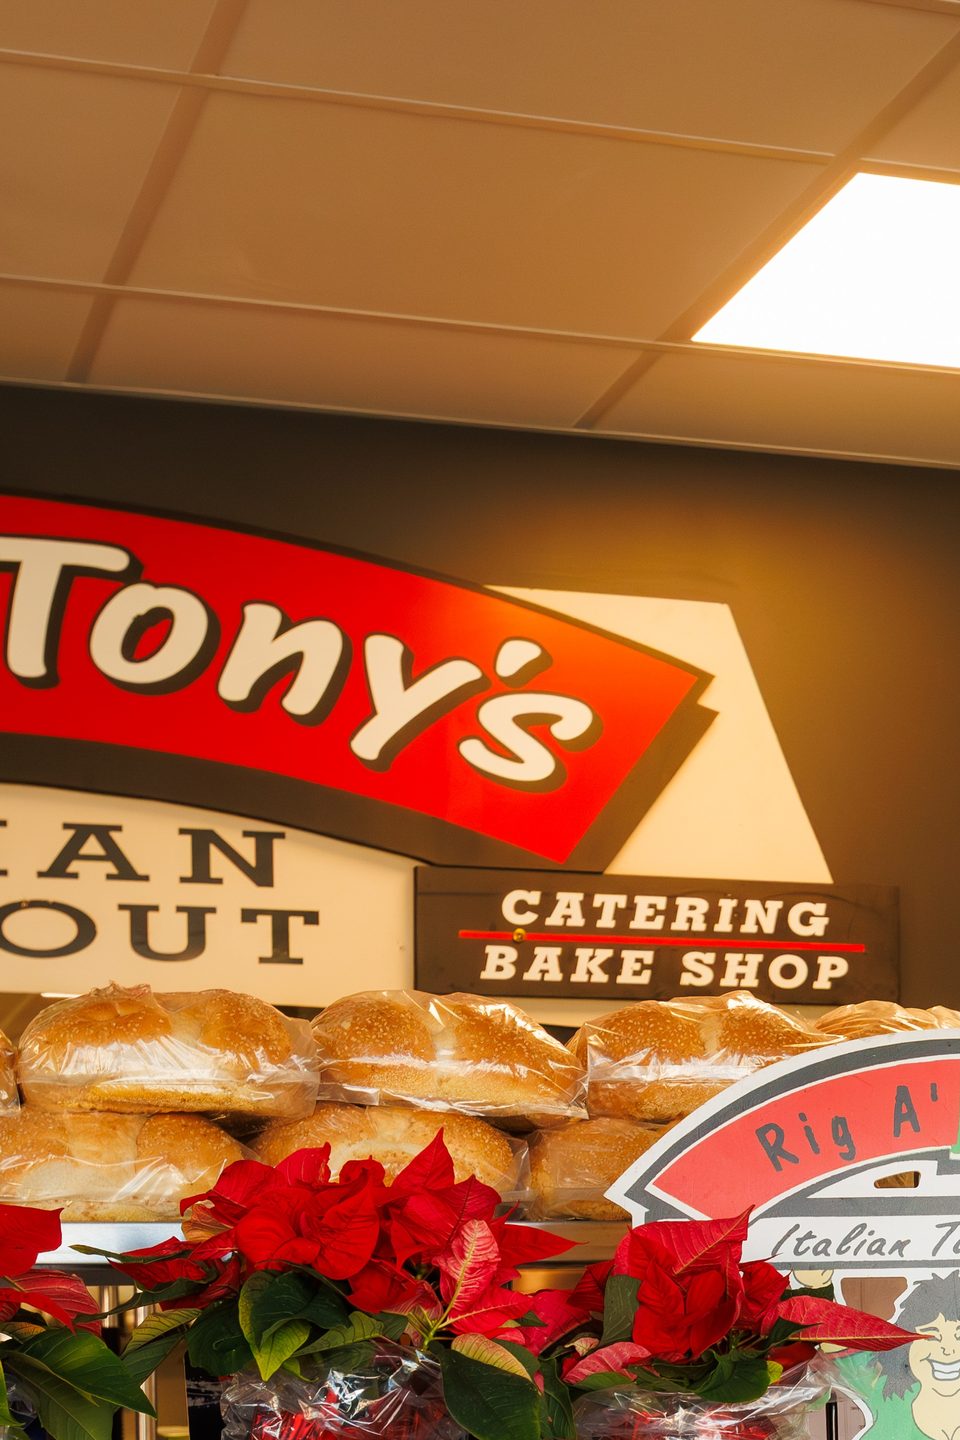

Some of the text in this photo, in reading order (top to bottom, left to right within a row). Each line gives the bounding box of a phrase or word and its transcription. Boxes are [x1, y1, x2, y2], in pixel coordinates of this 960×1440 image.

[0, 536, 594, 782] Tony's
[0, 820, 287, 888] AN
[0, 900, 320, 965] OUT
[501, 889, 830, 938] CATERING
[480, 945, 850, 990] BAKE SHOP
[755, 1111, 858, 1172] Rig
[893, 1082, 940, 1138] A'
[771, 1223, 911, 1258] Italian
